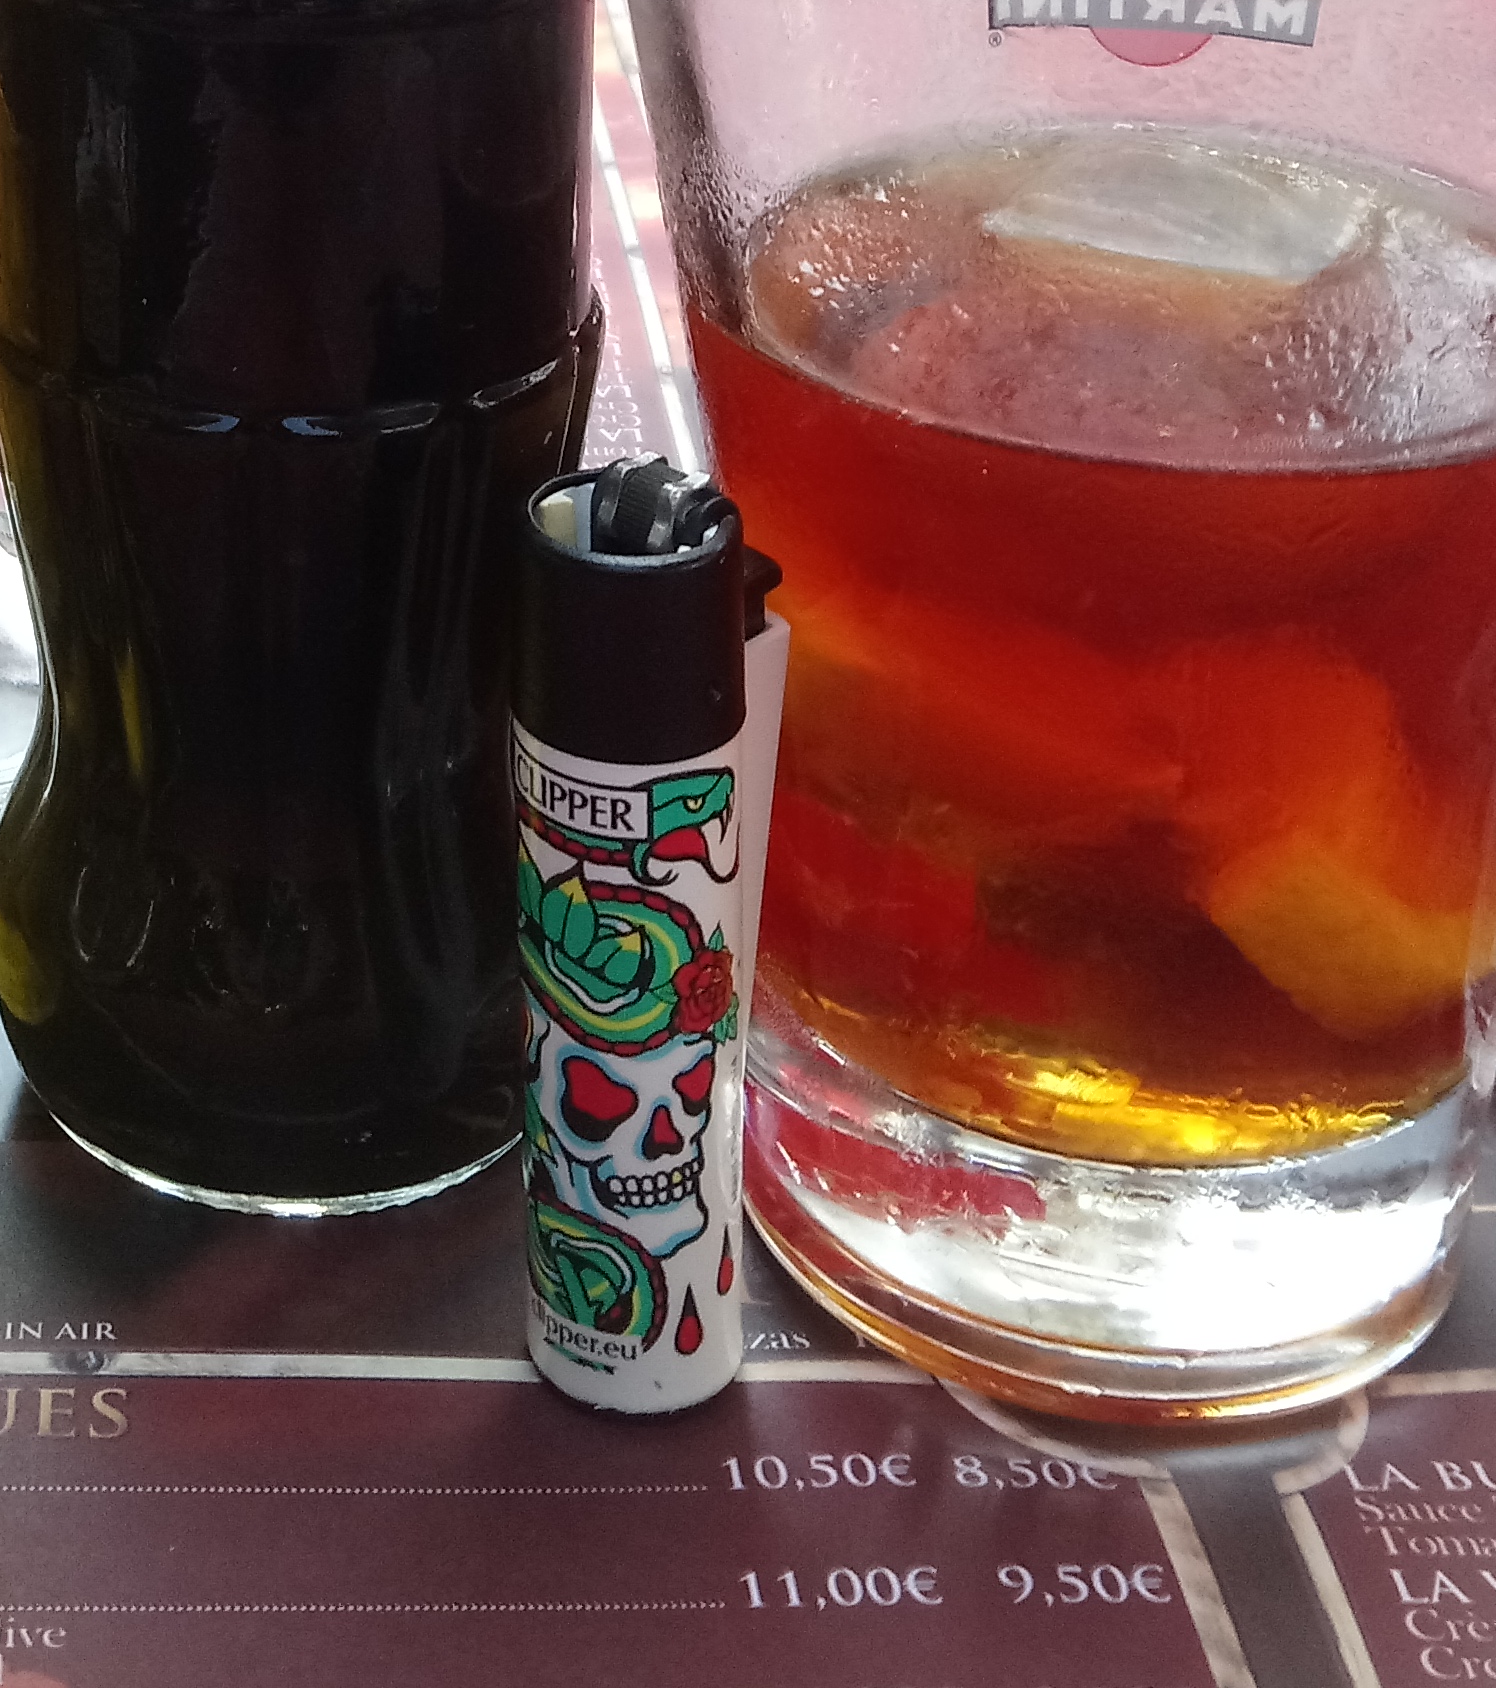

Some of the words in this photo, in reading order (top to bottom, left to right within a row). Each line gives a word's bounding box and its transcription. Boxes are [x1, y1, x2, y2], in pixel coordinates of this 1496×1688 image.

[516, 753, 636, 833] CLIPPER
[54, 1319, 120, 1342] AIR
[720, 1455, 917, 1493] 10,50€
[1342, 1459, 1420, 1493] LA
[1354, 1495, 1484, 1524] Sauce
[737, 1565, 944, 1612] 11,00€
[996, 1562, 1173, 1607] 9,50€
[1389, 1567, 1474, 1606] LA
